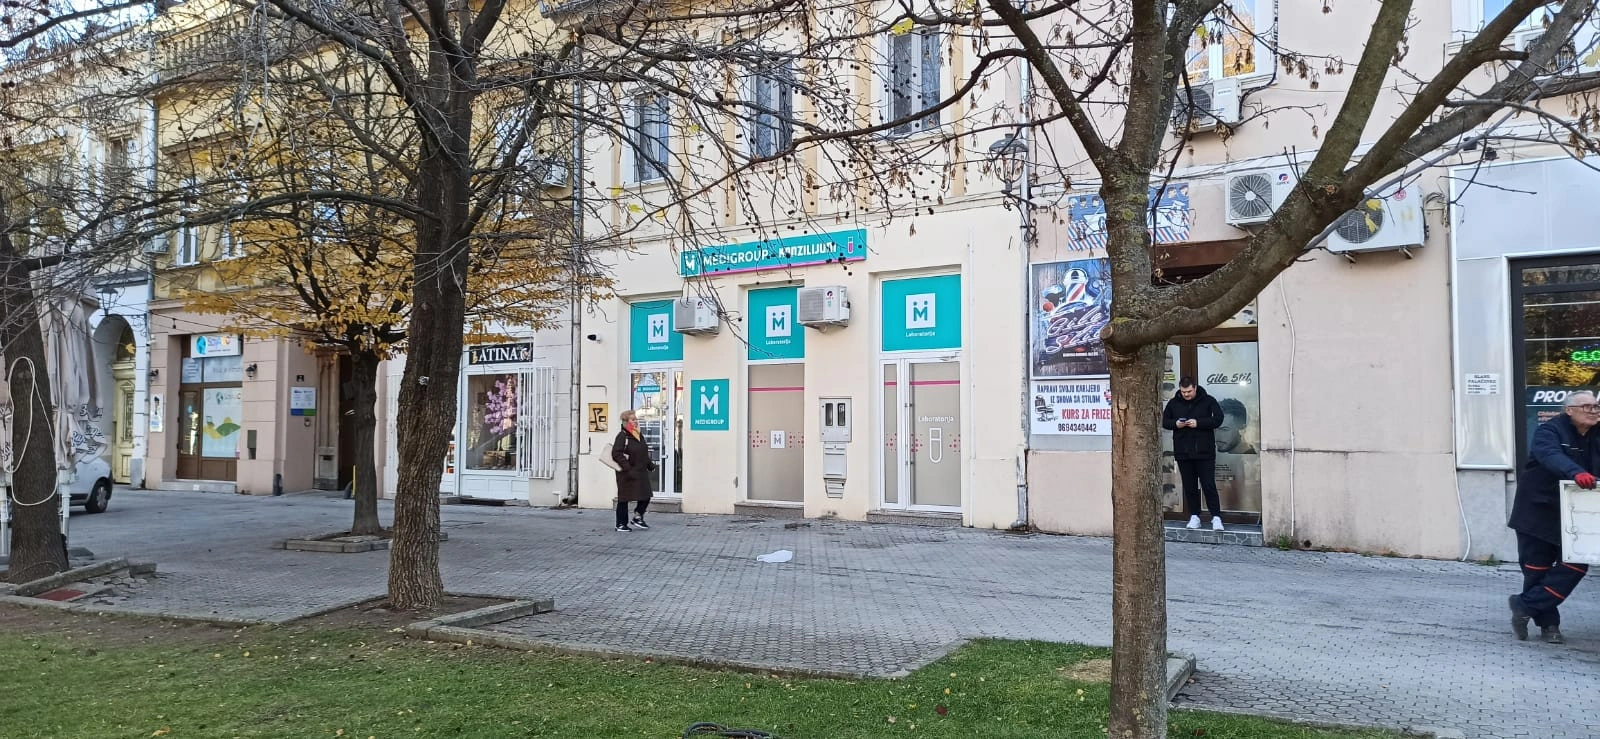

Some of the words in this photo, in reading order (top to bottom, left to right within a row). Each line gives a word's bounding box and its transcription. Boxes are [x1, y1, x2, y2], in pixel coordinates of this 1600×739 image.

[703, 249, 770, 266] MEDIGROUP
[1037, 385, 1058, 393] NAPRAVI
[1059, 385, 1075, 393] SVOJU
[1050, 395, 1056, 404] IZ
[1082, 395, 1101, 404] STILOM
[1062, 409, 1080, 420] KURS
[1082, 409, 1090, 420] ZA
